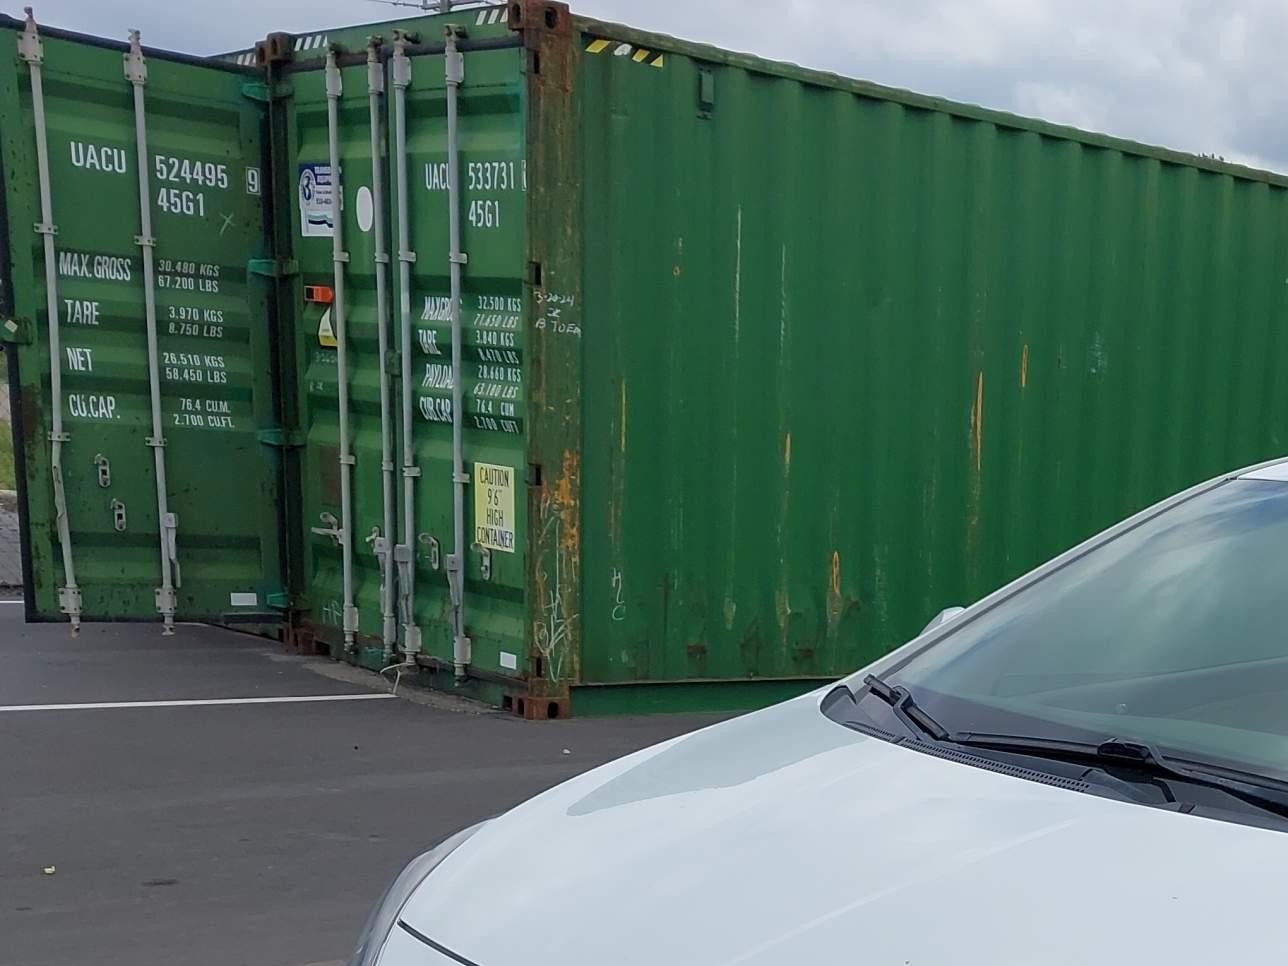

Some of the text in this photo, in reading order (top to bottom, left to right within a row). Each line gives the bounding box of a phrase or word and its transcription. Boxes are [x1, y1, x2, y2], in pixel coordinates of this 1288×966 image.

[70, 141, 259, 193] UACU 524495 9
[468, 161, 514, 190] 533731
[157, 187, 204, 216] 45G1
[468, 200, 500, 228] 45G1
[59, 252, 131, 281] MAX.GROSS
[200, 263, 220, 277] KGS
[158, 275, 218, 292] 67.200 LBS
[64, 299, 99, 325] TARE
[168, 306, 224, 323] 3.970 KGS
[203, 326, 223, 338] LBS
[66, 347, 93, 372] NET
[204, 355, 225, 368] KGS
[165, 367, 227, 383] 58.450 LBS
[421, 363, 455, 389] PAYLOA
[179, 398, 201, 411] 76.4
[173, 413, 205, 427] 2.700
[480, 467, 509, 488] CAUTION
[487, 507, 504, 527] HIGH
[477, 526, 513, 549] CONTAINER
